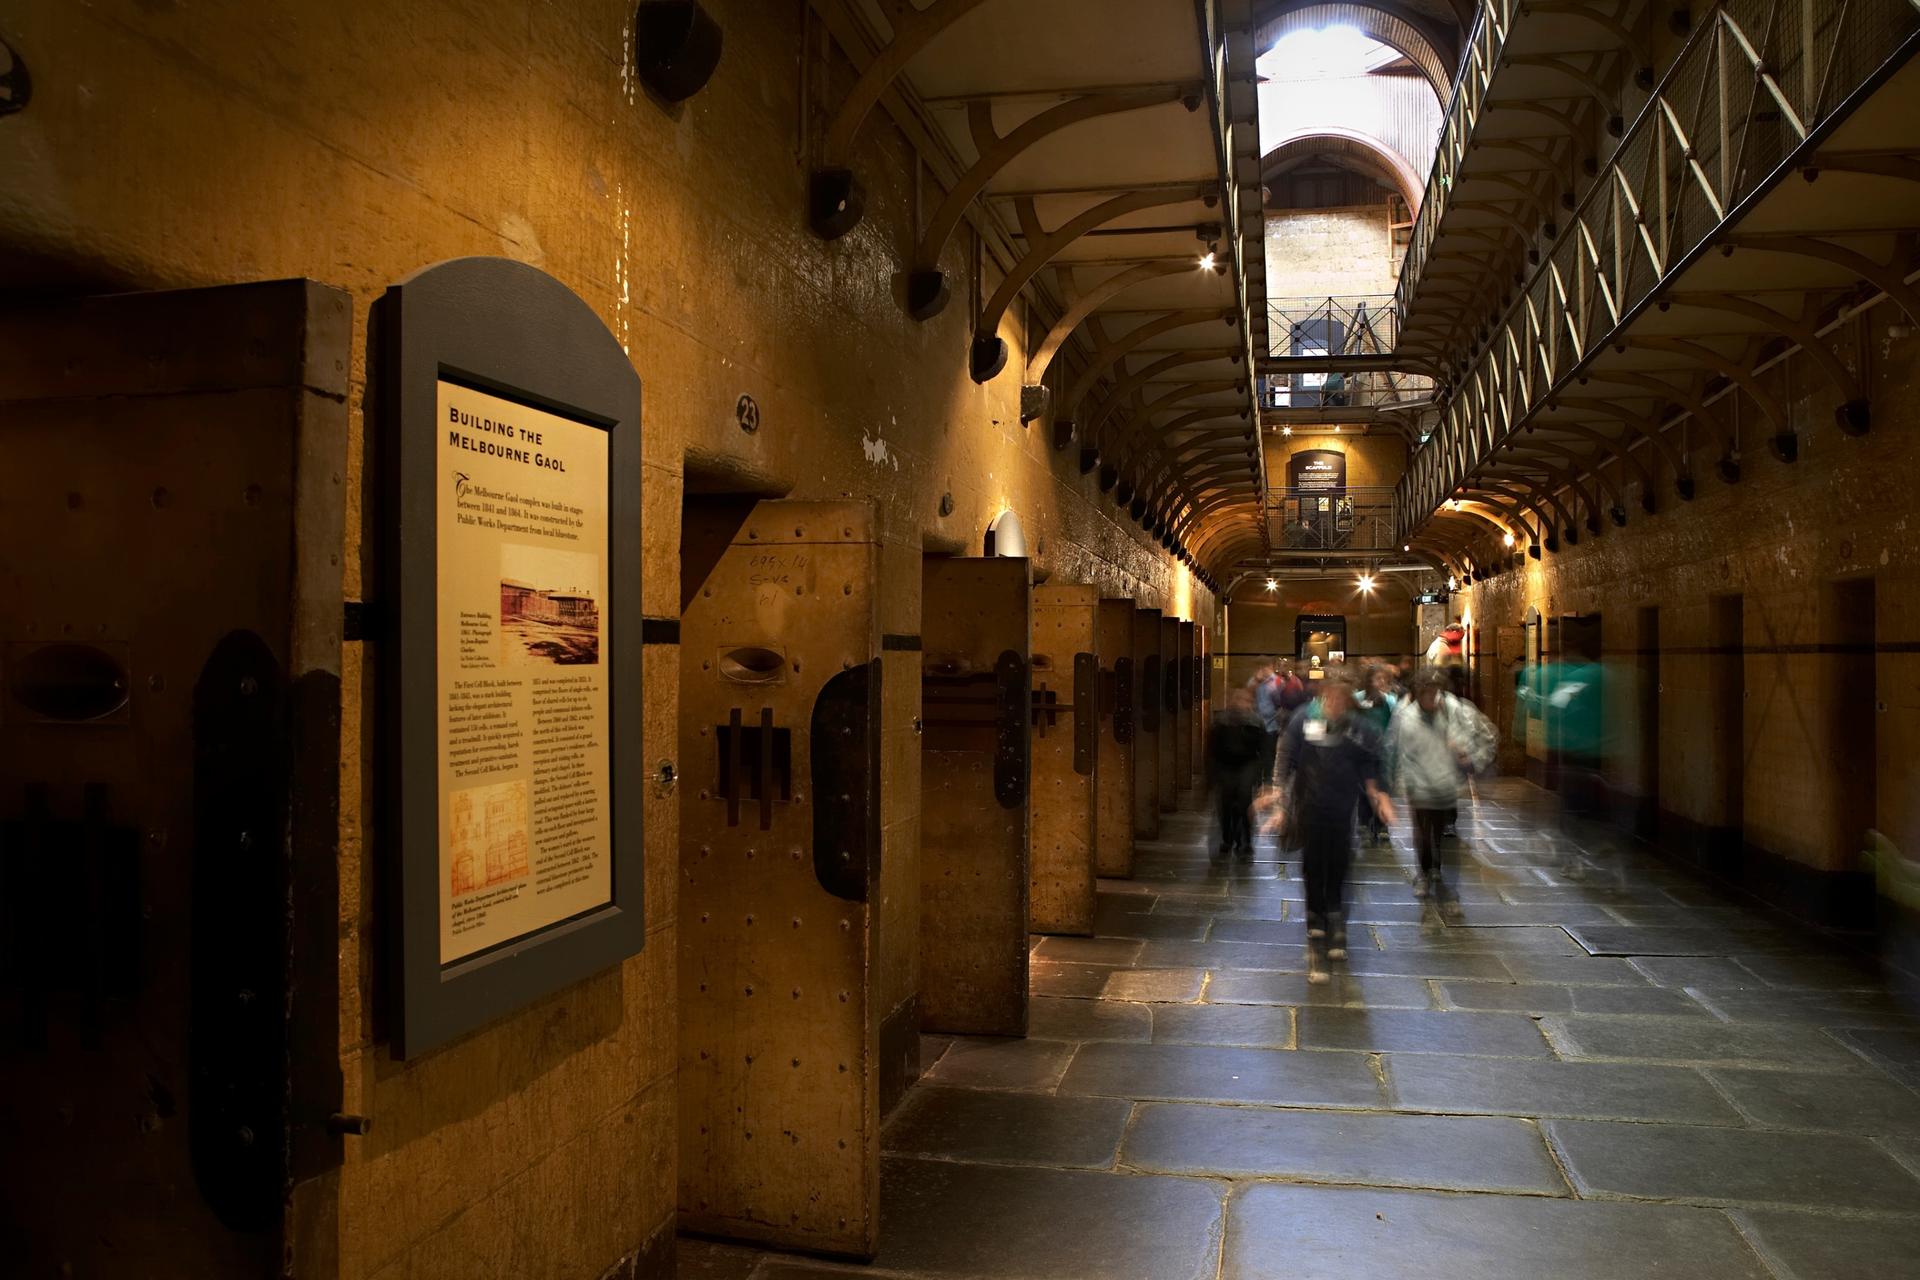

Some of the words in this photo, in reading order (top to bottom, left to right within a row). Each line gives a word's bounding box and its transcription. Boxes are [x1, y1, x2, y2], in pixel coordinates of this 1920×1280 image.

[450, 407, 514, 437] BUILDING
[519, 429, 542, 445] THE
[741, 397, 756, 429] 23
[450, 431, 530, 463] MELBOURNE
[535, 453, 565, 472] GAOL
[474, 485, 504, 501] Melbourne
[505, 492, 518, 503] Gaol
[457, 498, 480, 512] between
[496, 505, 507, 516] and
[575, 518, 583, 528] the
[457, 513, 476, 526] Public
[477, 516, 496, 528] Works
[497, 519, 529, 534] Department
